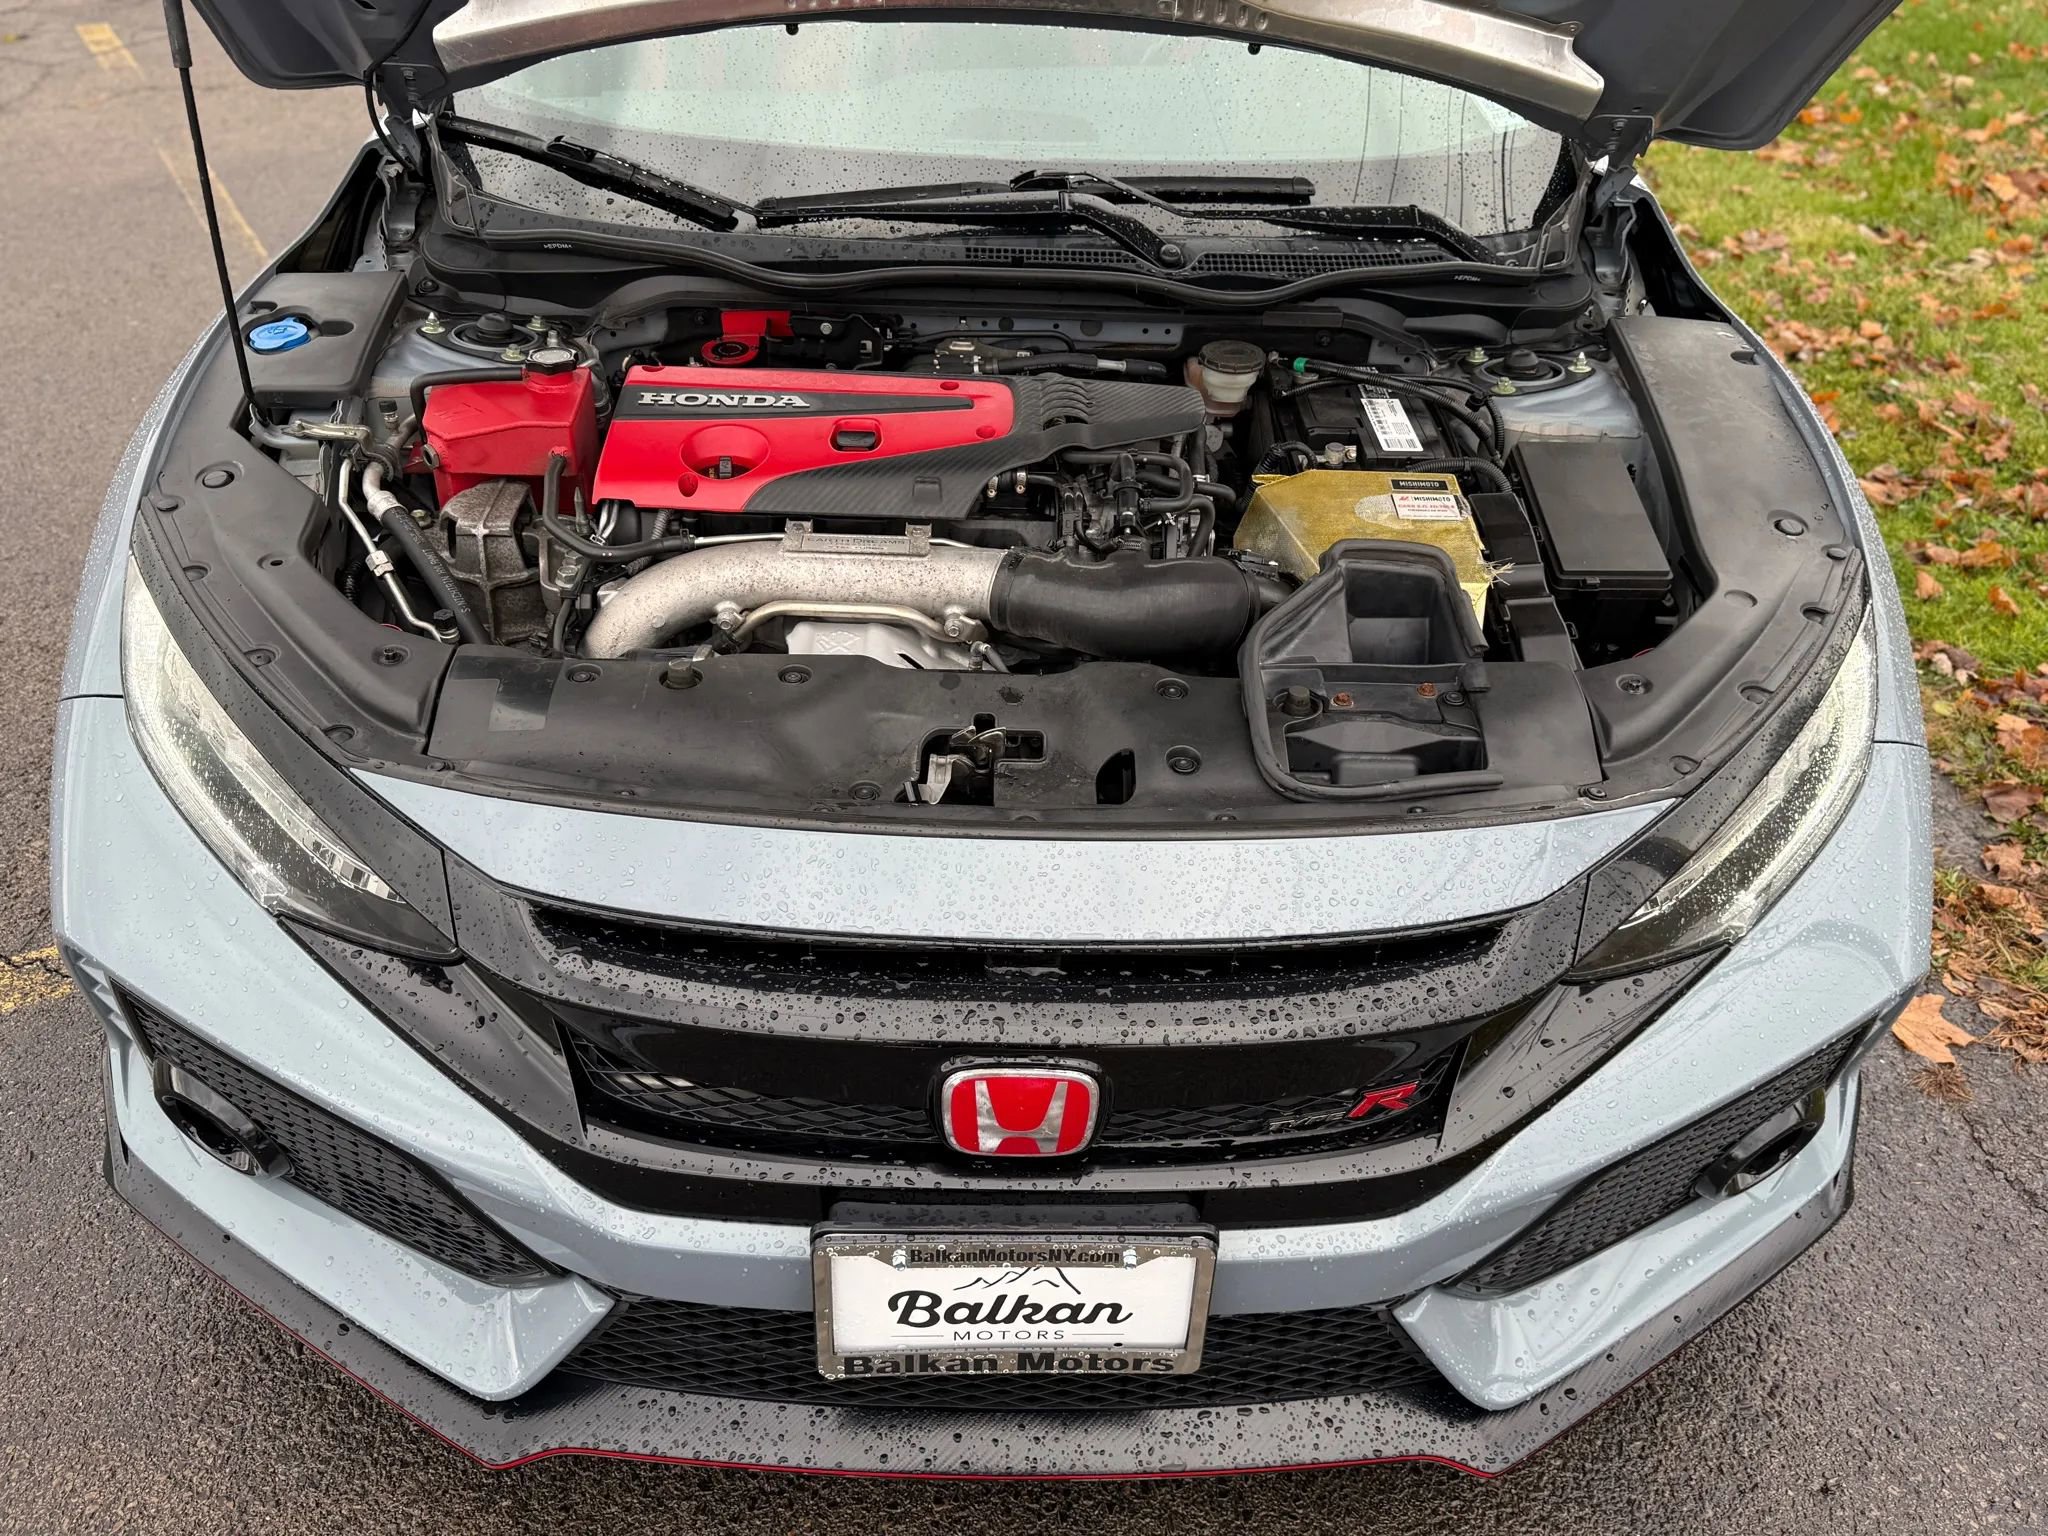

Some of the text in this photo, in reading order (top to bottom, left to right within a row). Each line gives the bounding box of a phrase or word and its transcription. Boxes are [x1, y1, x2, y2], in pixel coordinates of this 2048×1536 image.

[638, 392, 810, 408] HONDA
[1398, 480, 1440, 488] MISHIMOTO
[1347, 1080, 1420, 1120] R
[910, 1248, 1120, 1264] BalkanMotorsNY.com
[887, 1289, 1134, 1328] Balkan
[953, 1329, 1065, 1341] MOTORS
[844, 1351, 1175, 1375] Balkan Motors
